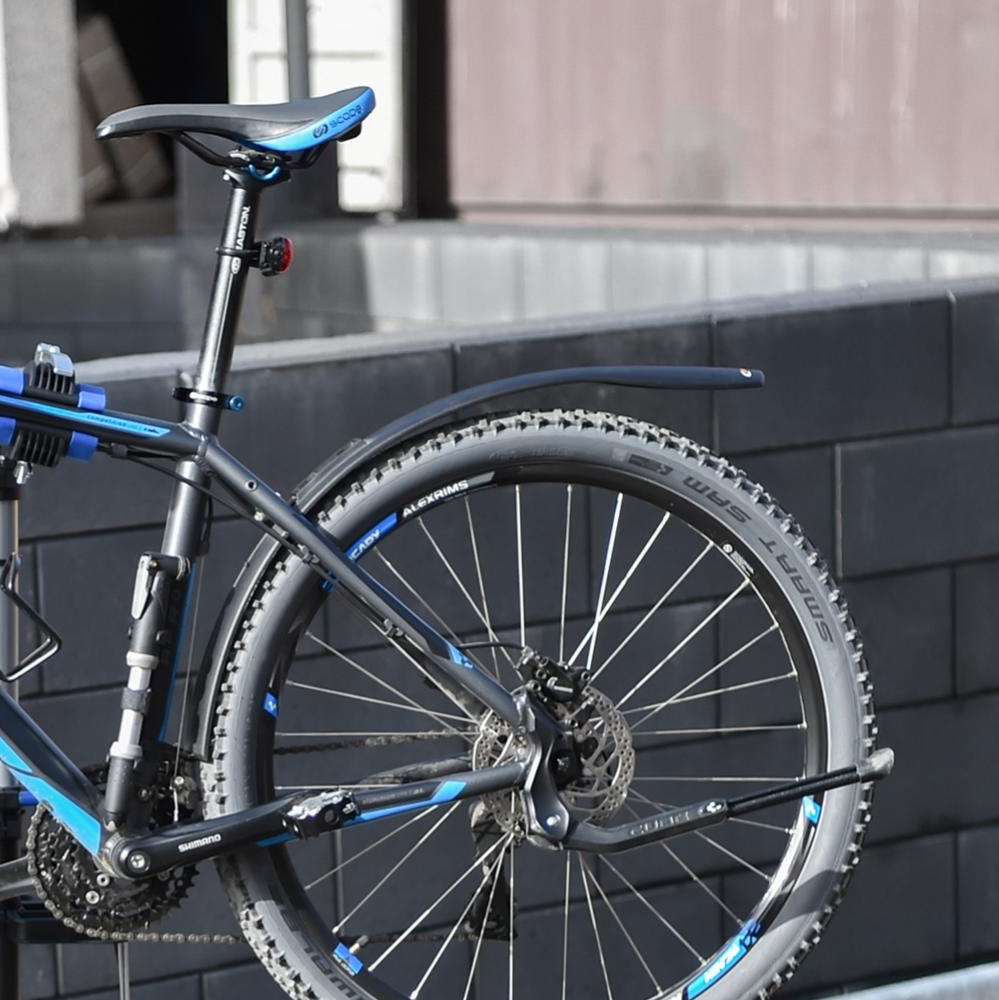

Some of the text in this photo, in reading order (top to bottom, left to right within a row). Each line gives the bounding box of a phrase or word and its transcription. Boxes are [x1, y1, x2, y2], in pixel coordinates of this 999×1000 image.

[402, 479, 469, 518] ALEXRIMS
[348, 528, 380, 560] CADY
[758, 538, 834, 644] SMART
[177, 832, 222, 853] SHIMANO
